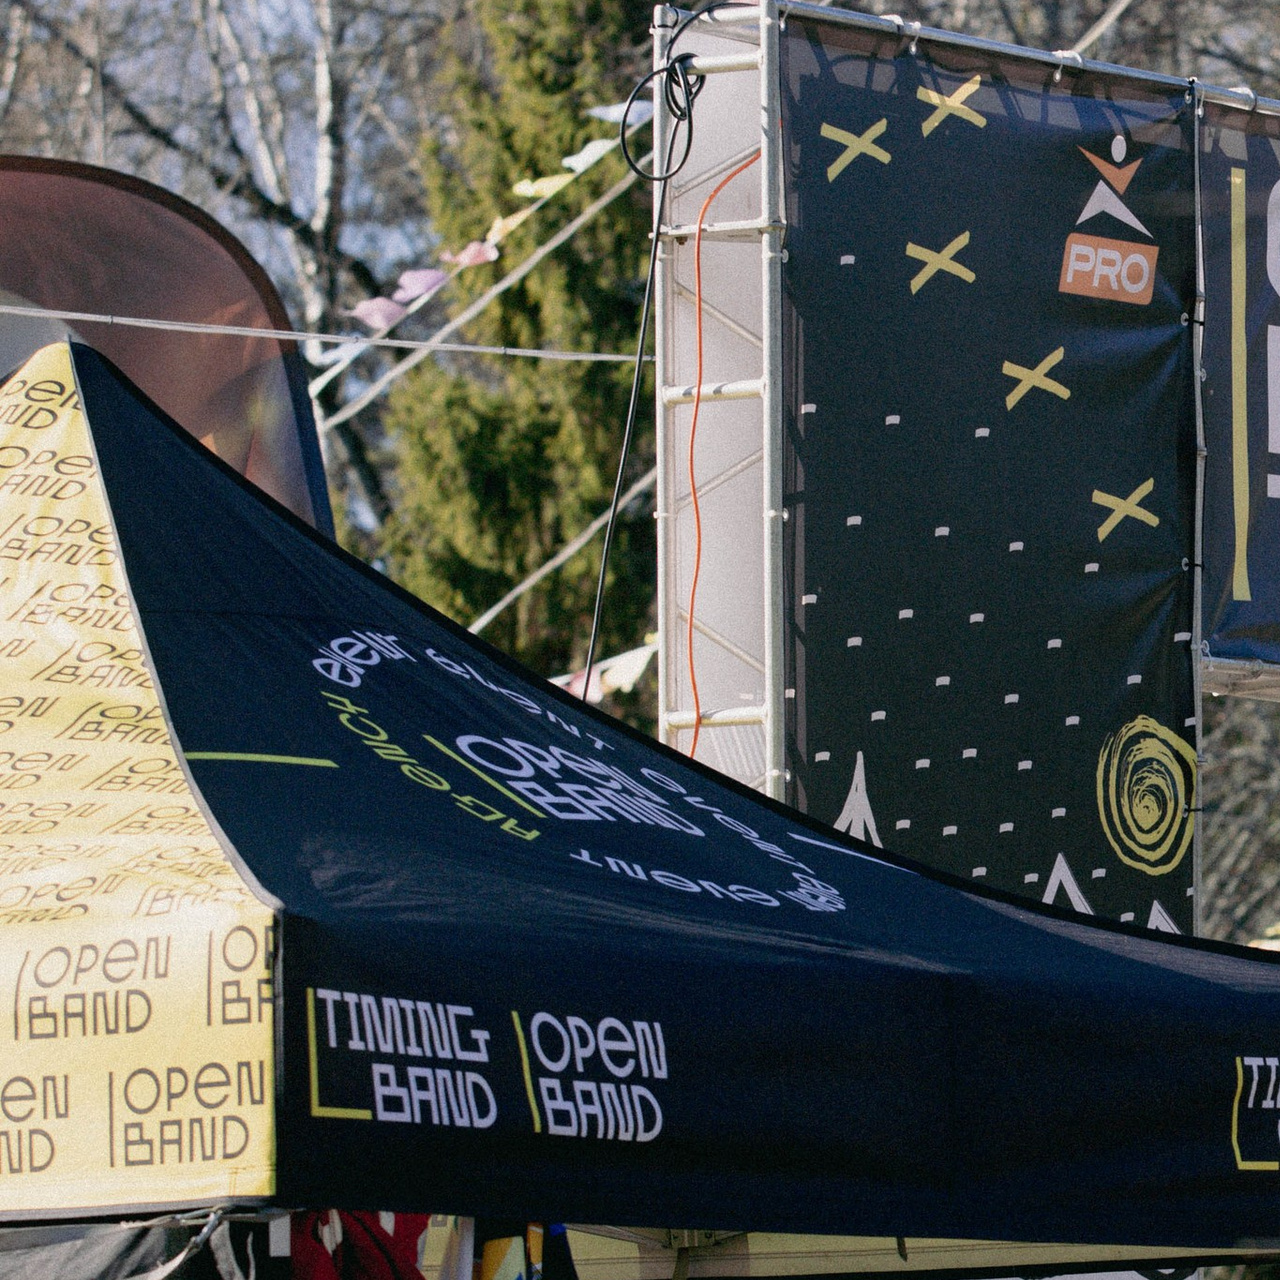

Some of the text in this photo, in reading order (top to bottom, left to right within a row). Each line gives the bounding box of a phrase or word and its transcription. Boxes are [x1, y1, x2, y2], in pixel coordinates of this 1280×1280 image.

[1067, 245, 1149, 292] PRO
[28, 989, 152, 1040] BAND
[317, 988, 490, 1062] TIMING
[372, 1063, 498, 1129] BAND
[539, 1077, 663, 1142] BAND
[124, 1115, 250, 1166] BAND
